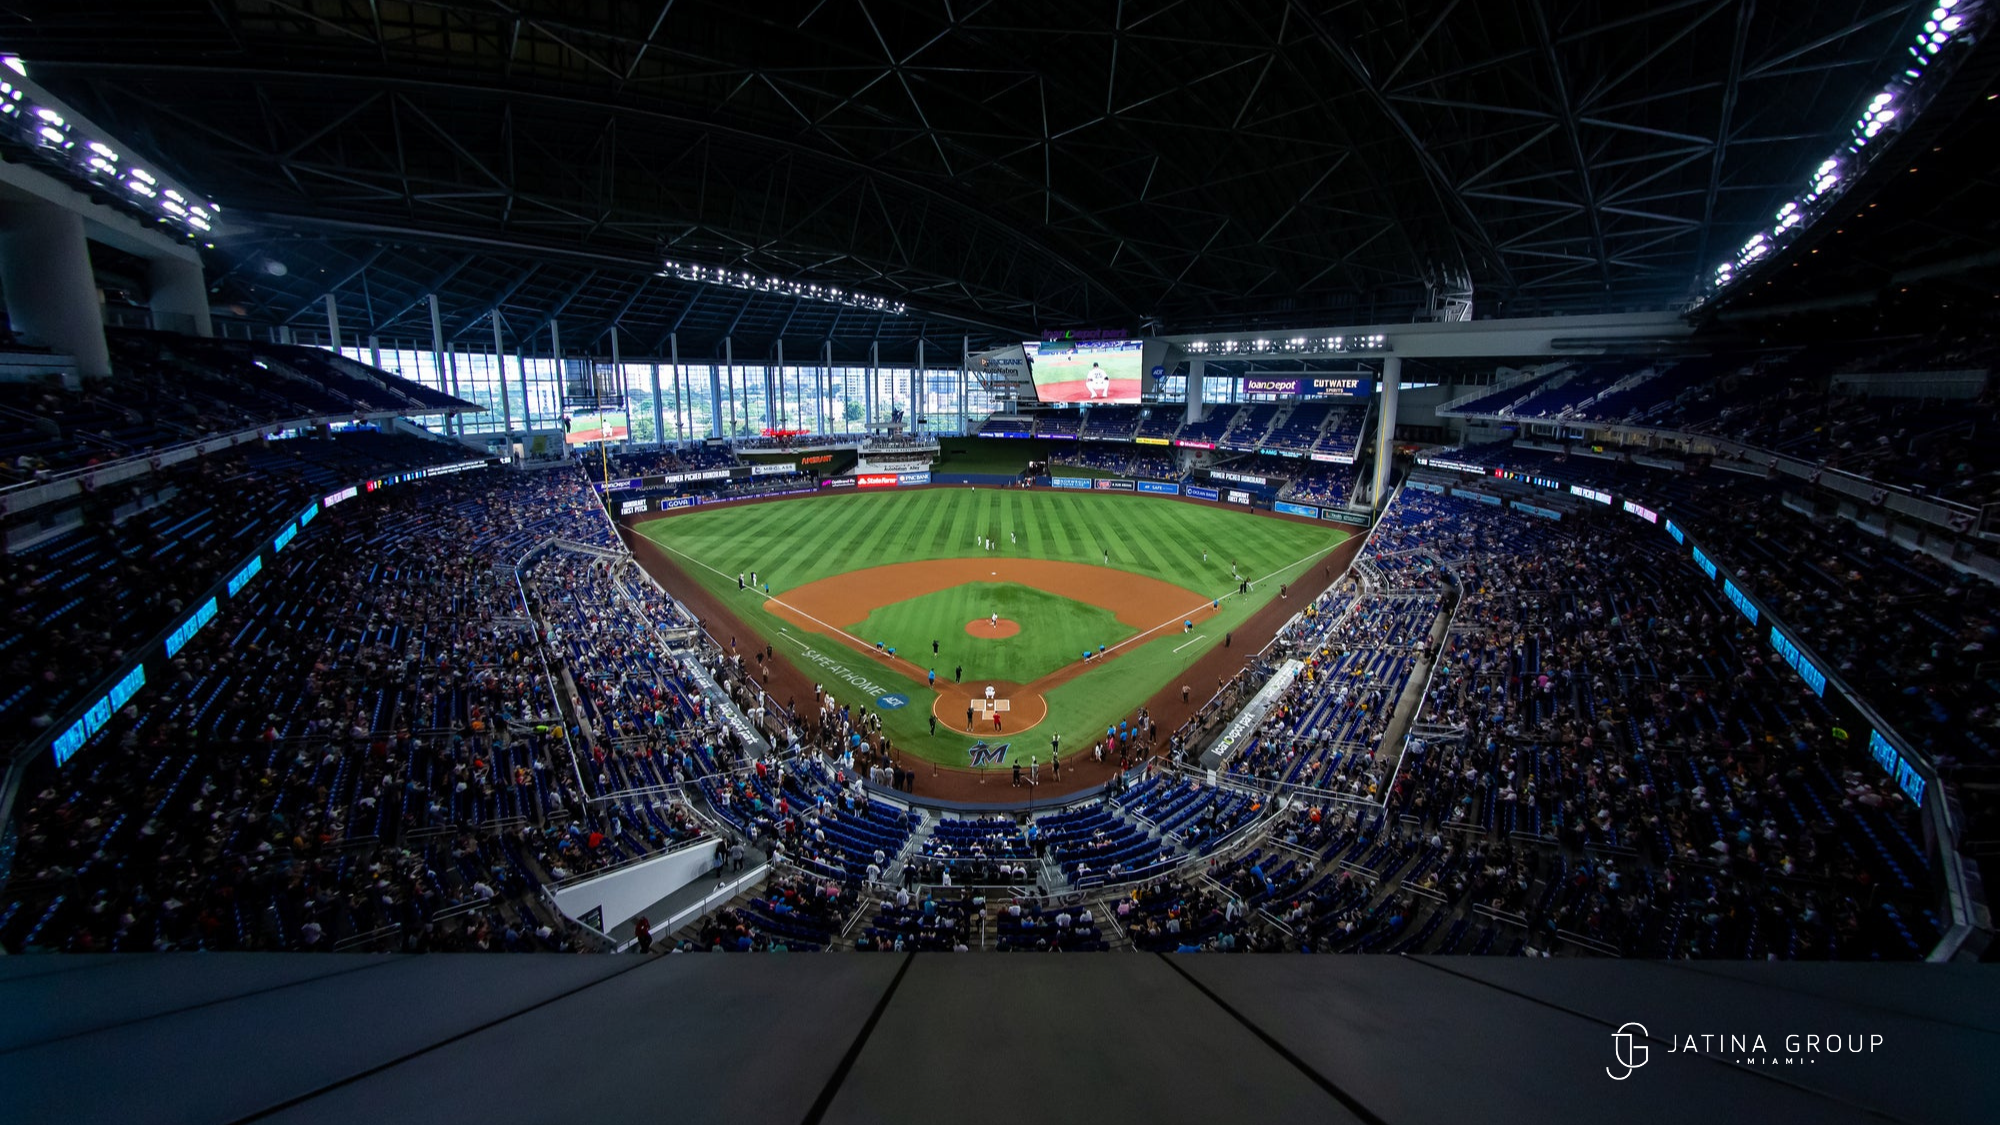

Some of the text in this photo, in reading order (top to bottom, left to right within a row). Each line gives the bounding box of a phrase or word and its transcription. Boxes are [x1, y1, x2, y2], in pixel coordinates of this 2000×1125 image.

[1248, 380, 1296, 391] loanDepot
[1314, 379, 1358, 388] CUTWATER
[665, 475, 683, 483] PRIMER
[668, 499, 688, 507] GOYA
[802, 650, 887, 696] SAFE AT HOME
[883, 697, 904, 706] ADT
[1211, 711, 1256, 756] loanDepot park
